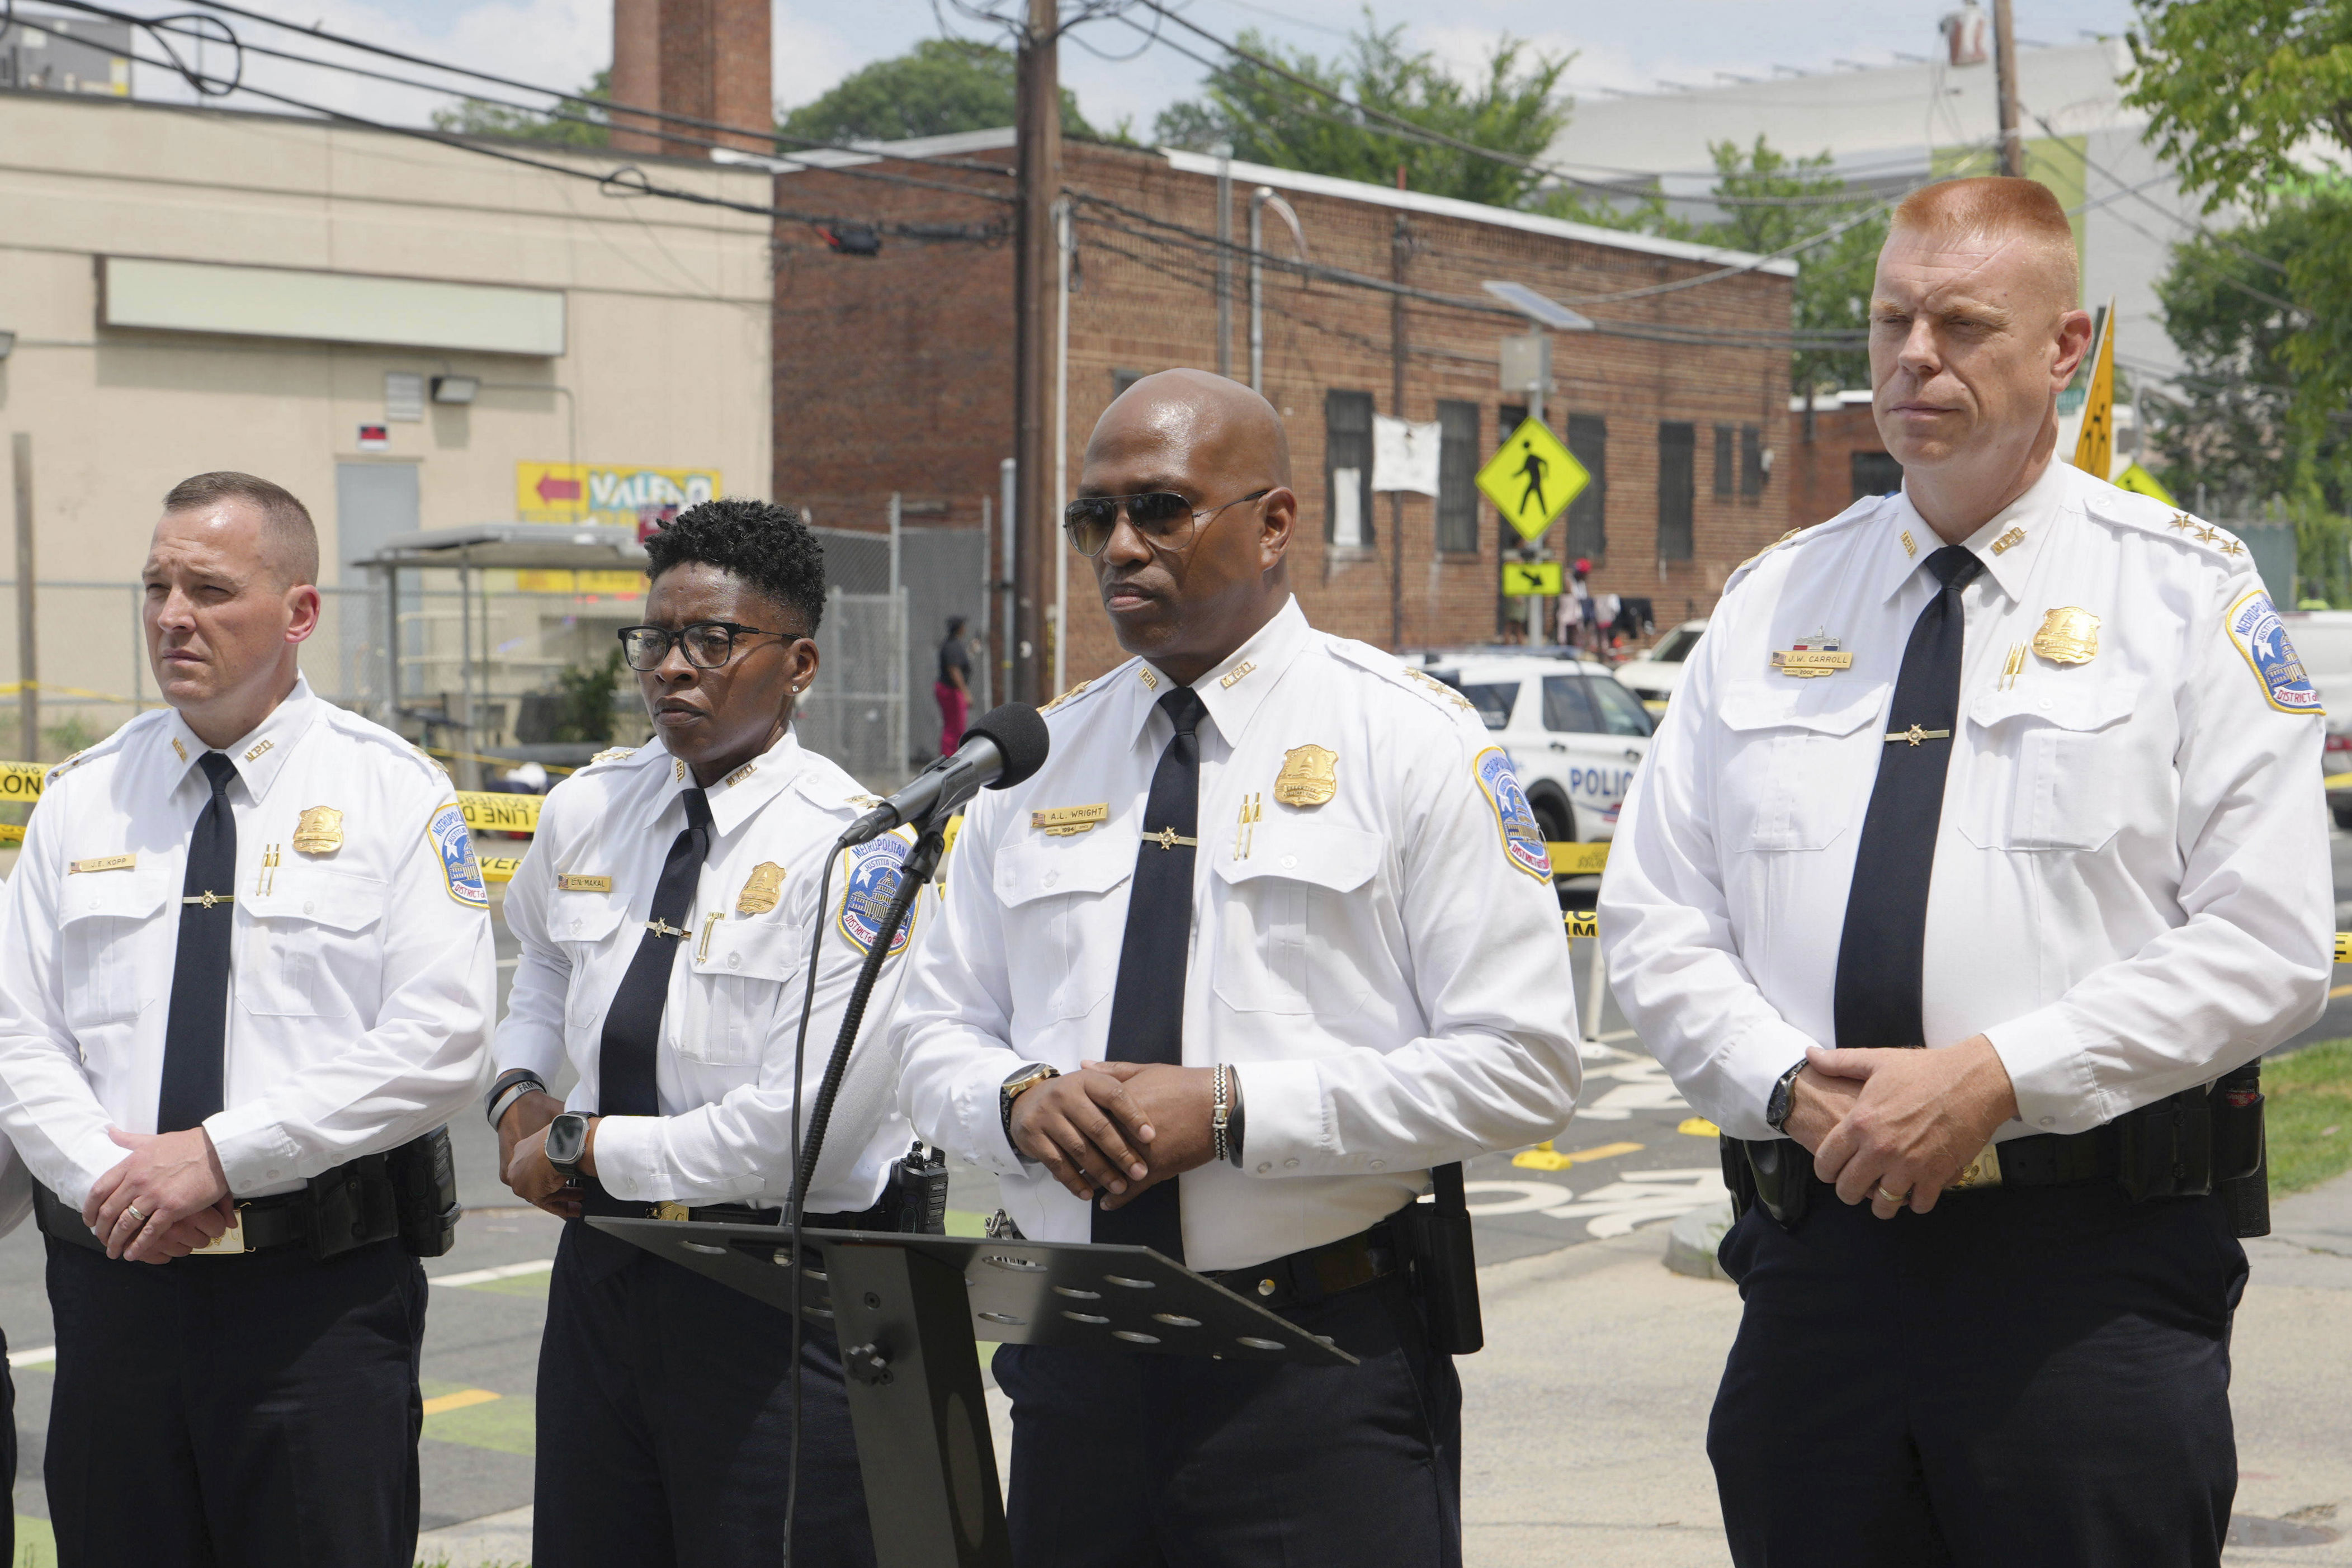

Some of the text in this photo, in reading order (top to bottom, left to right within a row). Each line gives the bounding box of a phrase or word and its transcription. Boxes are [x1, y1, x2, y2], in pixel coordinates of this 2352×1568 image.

[1051, 807, 1104, 820] A.L. WRIGHT
[851, 839, 907, 859] METROPOLITAN
[107, 858, 127, 866] KOPP
[845, 915, 871, 941] DISTRICT
